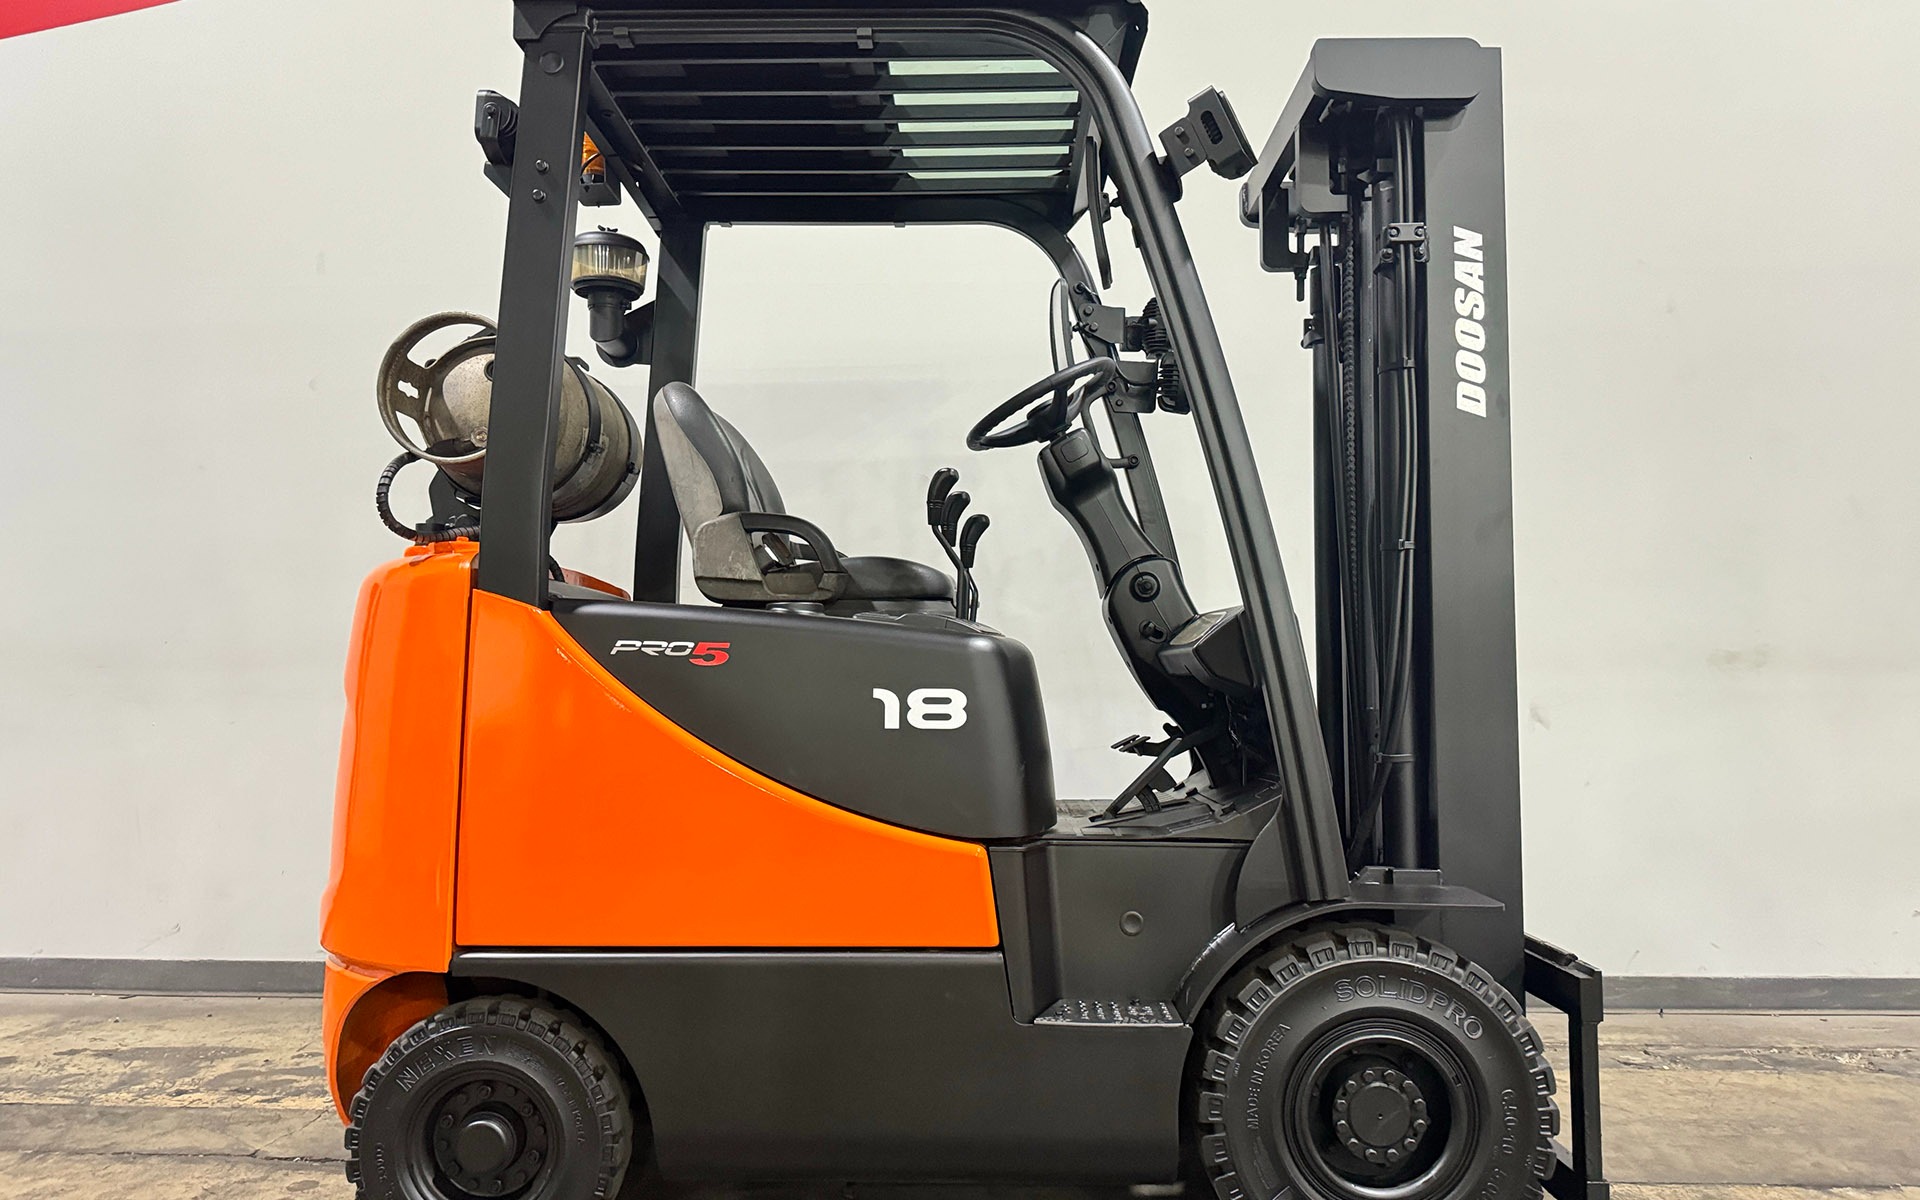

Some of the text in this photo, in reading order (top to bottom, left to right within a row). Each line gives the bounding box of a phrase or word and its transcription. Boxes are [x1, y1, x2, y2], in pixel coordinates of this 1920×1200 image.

[1453, 225, 1487, 418] DOOSAN
[610, 639, 731, 666] PRO5
[873, 687, 968, 730] 18
[1334, 975, 1484, 1040] SOLIDPRO
[395, 1035, 498, 1092] NEXEN
[1247, 1023, 1292, 1130] MADE IN KOREA
